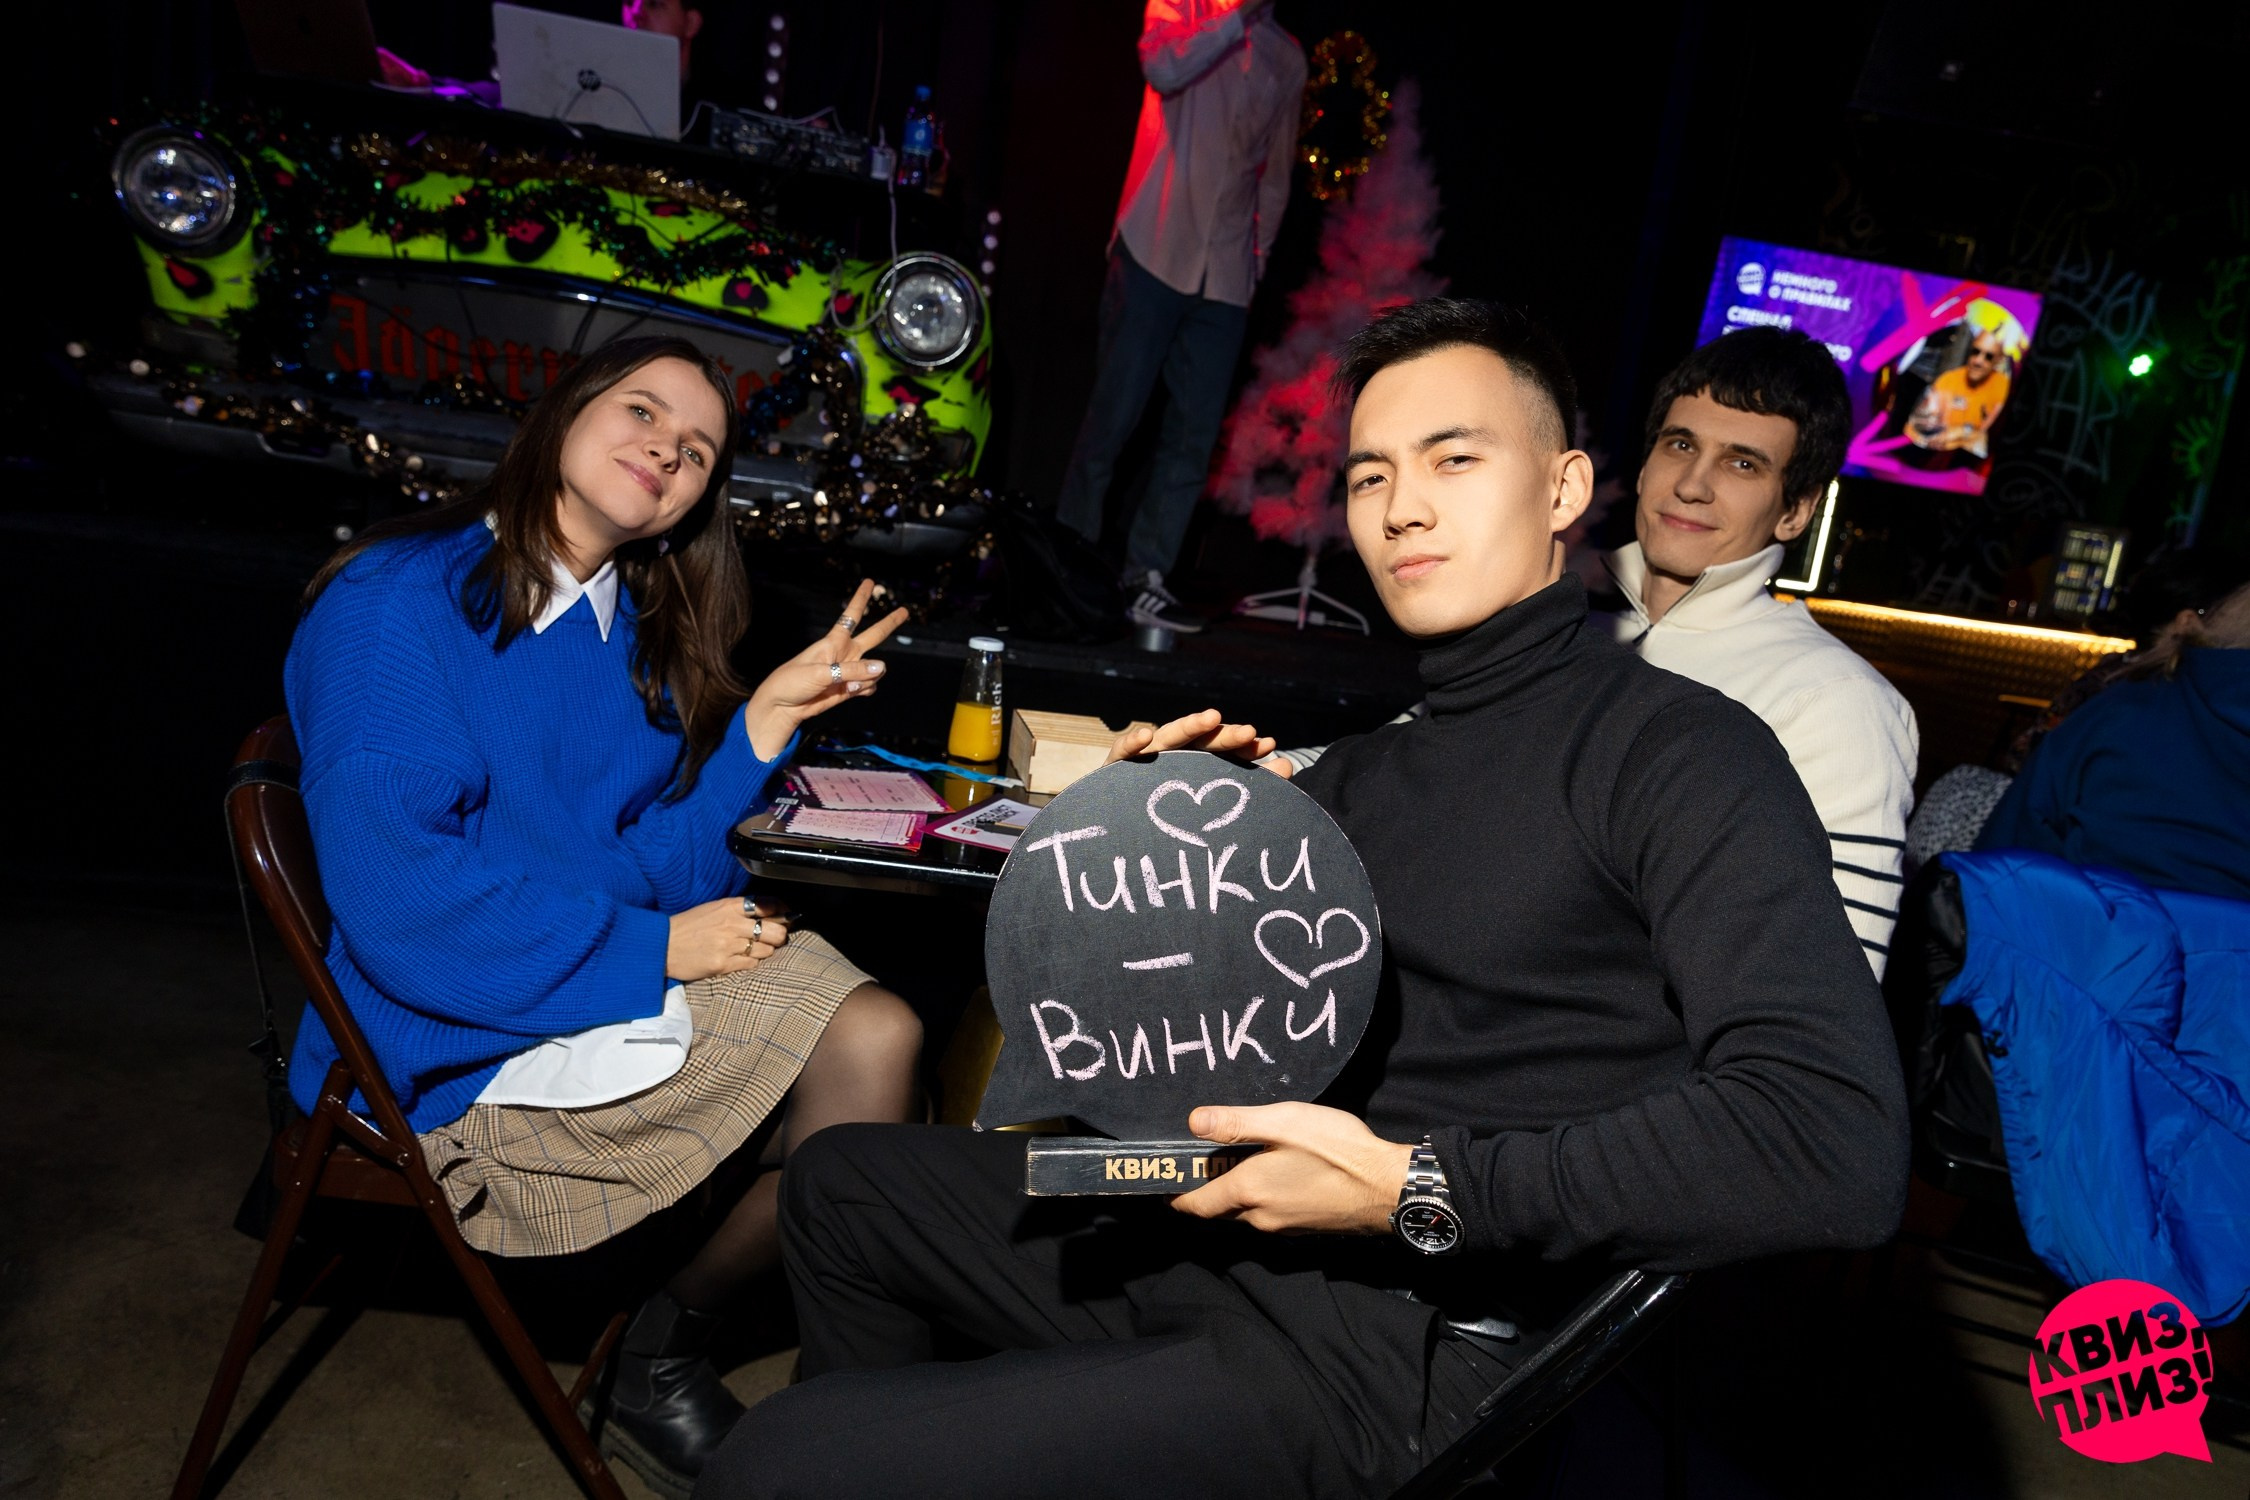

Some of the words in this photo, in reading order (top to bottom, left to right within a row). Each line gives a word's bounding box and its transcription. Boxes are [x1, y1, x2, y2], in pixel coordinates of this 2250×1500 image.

[1027, 825, 1316, 914] Тинки
[1030, 988, 1336, 1081] Винки
[1105, 1157, 1185, 1183] КВИЗ,
[1192, 1157, 1237, 1180] ПЛ
